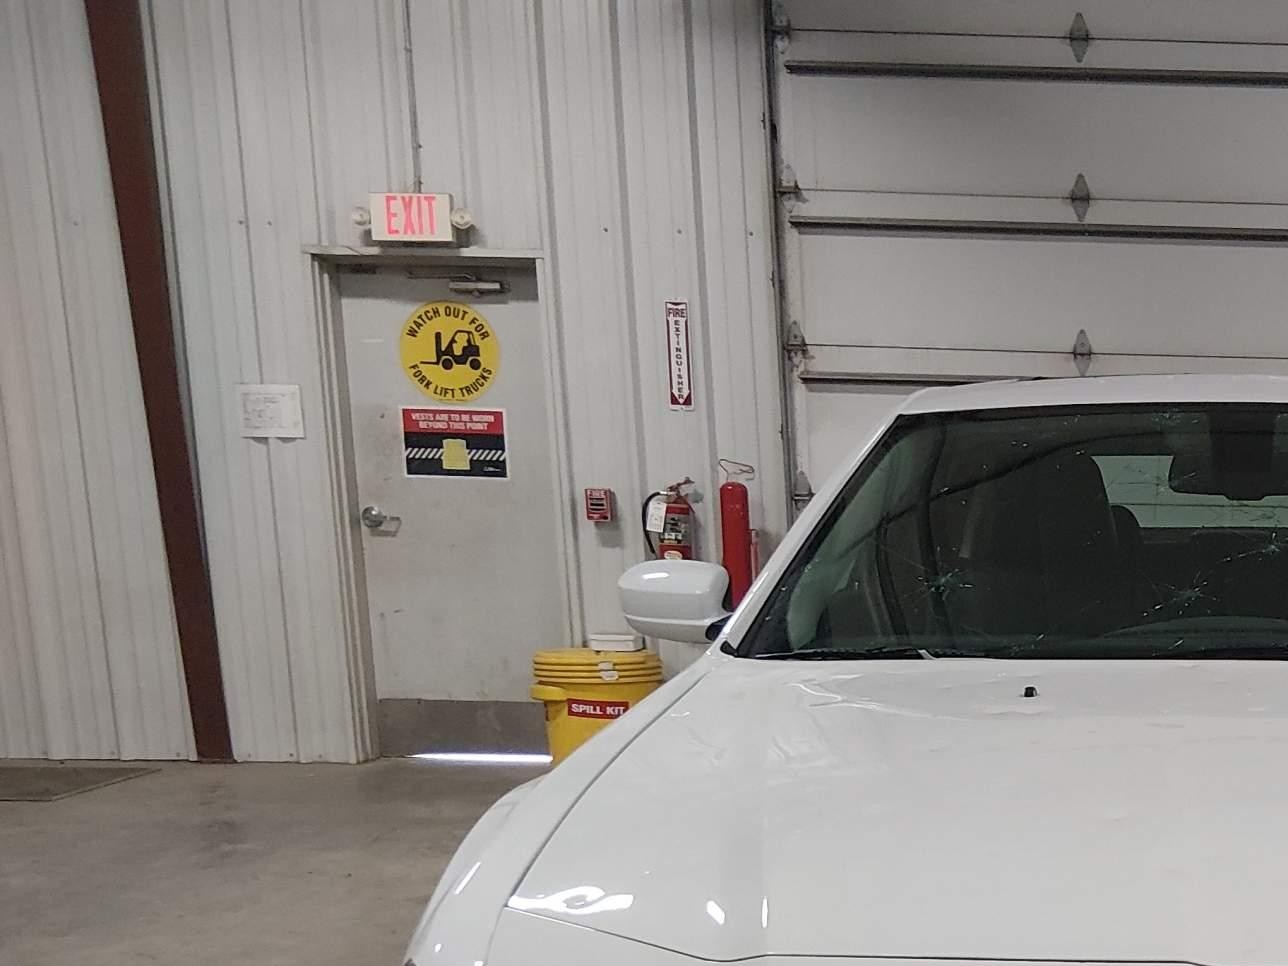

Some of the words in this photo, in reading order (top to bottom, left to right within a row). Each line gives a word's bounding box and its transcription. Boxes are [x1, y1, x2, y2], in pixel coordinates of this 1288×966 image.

[384, 195, 436, 235] EXIT
[406, 306, 441, 338] WATCH
[444, 305, 469, 321] OUT
[468, 317, 490, 341] FOR
[667, 308, 686, 318] FIRE
[673, 319, 684, 400] EXTINGUISHER
[408, 363, 432, 390] FORK
[433, 385, 456, 399] LIFT
[458, 367, 493, 398] TRUCKS
[588, 490, 606, 498] FIRE
[571, 703, 603, 715] SPILL
[606, 705, 625, 716] KIT
